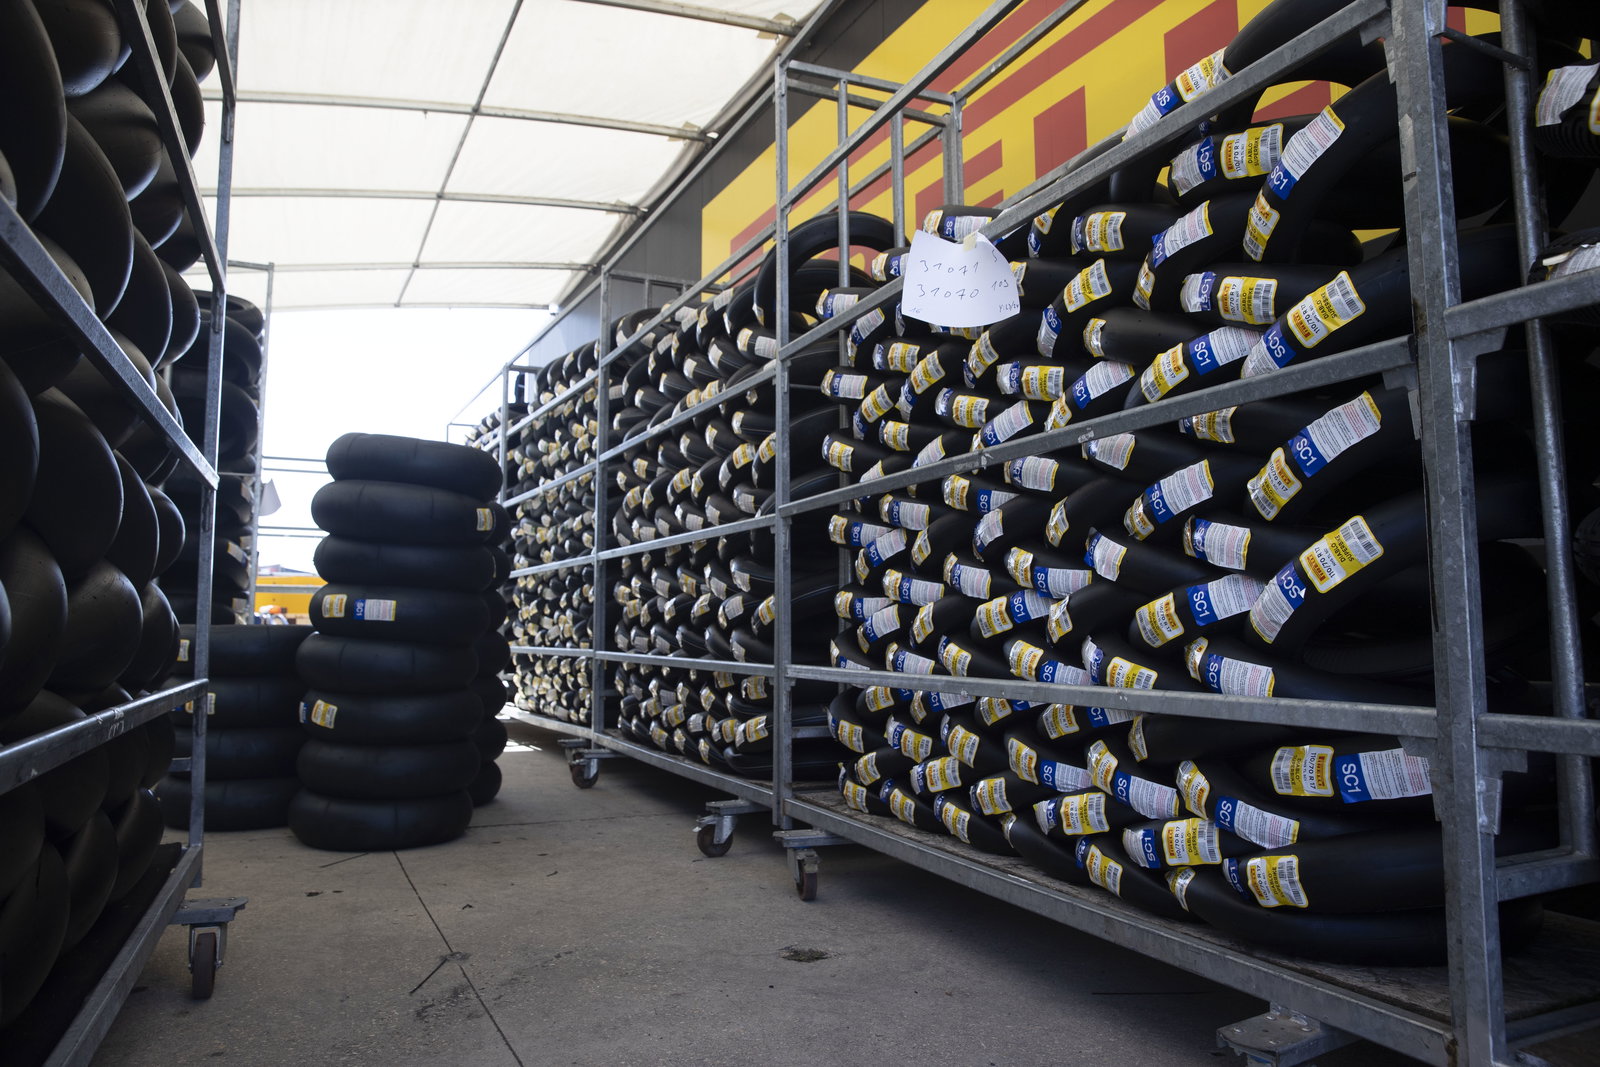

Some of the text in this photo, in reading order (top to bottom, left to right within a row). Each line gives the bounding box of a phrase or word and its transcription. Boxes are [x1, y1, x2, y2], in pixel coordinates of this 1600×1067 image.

[1189, 72, 1201, 89] 110/70
[1157, 90, 1170, 106] SC
[1200, 146, 1211, 172] SC1
[1225, 142, 1233, 169] PIRELLI
[1271, 166, 1288, 190] SC1
[920, 260, 978, 275] 31071
[918, 284, 979, 300] 31070
[1200, 279, 1212, 303] SC1
[1315, 299, 1329, 319] DIABLO
[1319, 292, 1337, 319] SUPERBIKE
[1291, 311, 1311, 337] PIRELLI
[1303, 313, 1320, 333] 110/70
[1194, 341, 1211, 366] SC1
[1268, 331, 1285, 358] SC1
[1075, 381, 1086, 401] SC1
[985, 425, 995, 444] SC1
[1296, 438, 1318, 466] SC1
[1280, 484, 1288, 492] 17
[980, 494, 988, 512] SC1
[1151, 490, 1165, 516] SC1
[869, 545, 878, 561] SC1
[1330, 542, 1346, 562] DIABLO
[1333, 534, 1354, 562] SUPERBIKE
[1305, 554, 1326, 581] PIRELLI
[1319, 556, 1335, 578] 110/70
[1037, 572, 1047, 593] SC1
[1281, 570, 1301, 598] SC1
[1014, 596, 1025, 617] SC1
[1193, 591, 1210, 617] SC1
[865, 621, 874, 637] SC1
[1042, 664, 1053, 682] SC
[1209, 663, 1218, 689] SC1
[1090, 707, 1104, 722] C1
[1043, 765, 1053, 786] SC1
[1342, 763, 1362, 792] SC1
[1118, 778, 1127, 801] SC1
[1220, 800, 1232, 828] SC1
[1144, 837, 1156, 861] SC1
[1166, 828, 1175, 856] PIRELLI
[1267, 873, 1278, 895] DIABLO
[1270, 866, 1285, 898] SUPERBIKE
